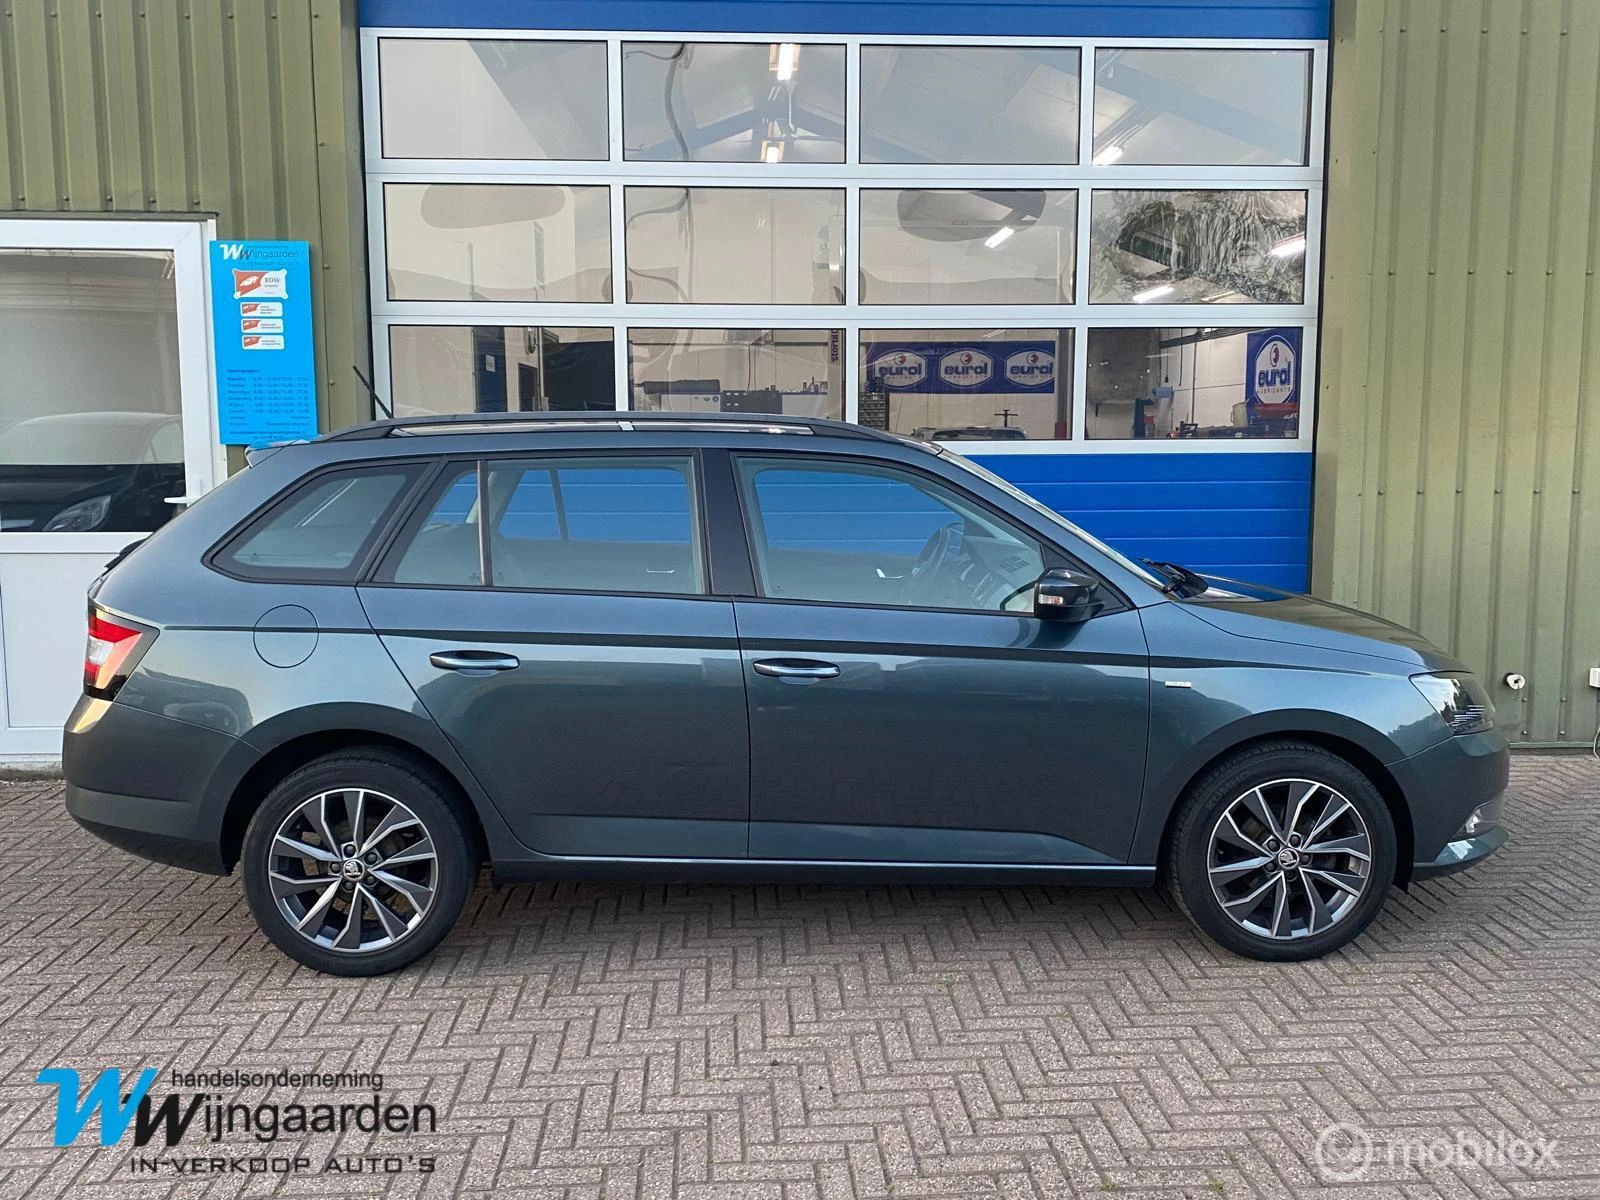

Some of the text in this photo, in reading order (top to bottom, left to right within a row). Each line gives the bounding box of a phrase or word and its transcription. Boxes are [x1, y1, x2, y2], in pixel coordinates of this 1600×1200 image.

[879, 362, 922, 376] eurol
[944, 362, 988, 376] eurol
[1010, 362, 1054, 376] eurol
[1258, 360, 1291, 388] eurol
